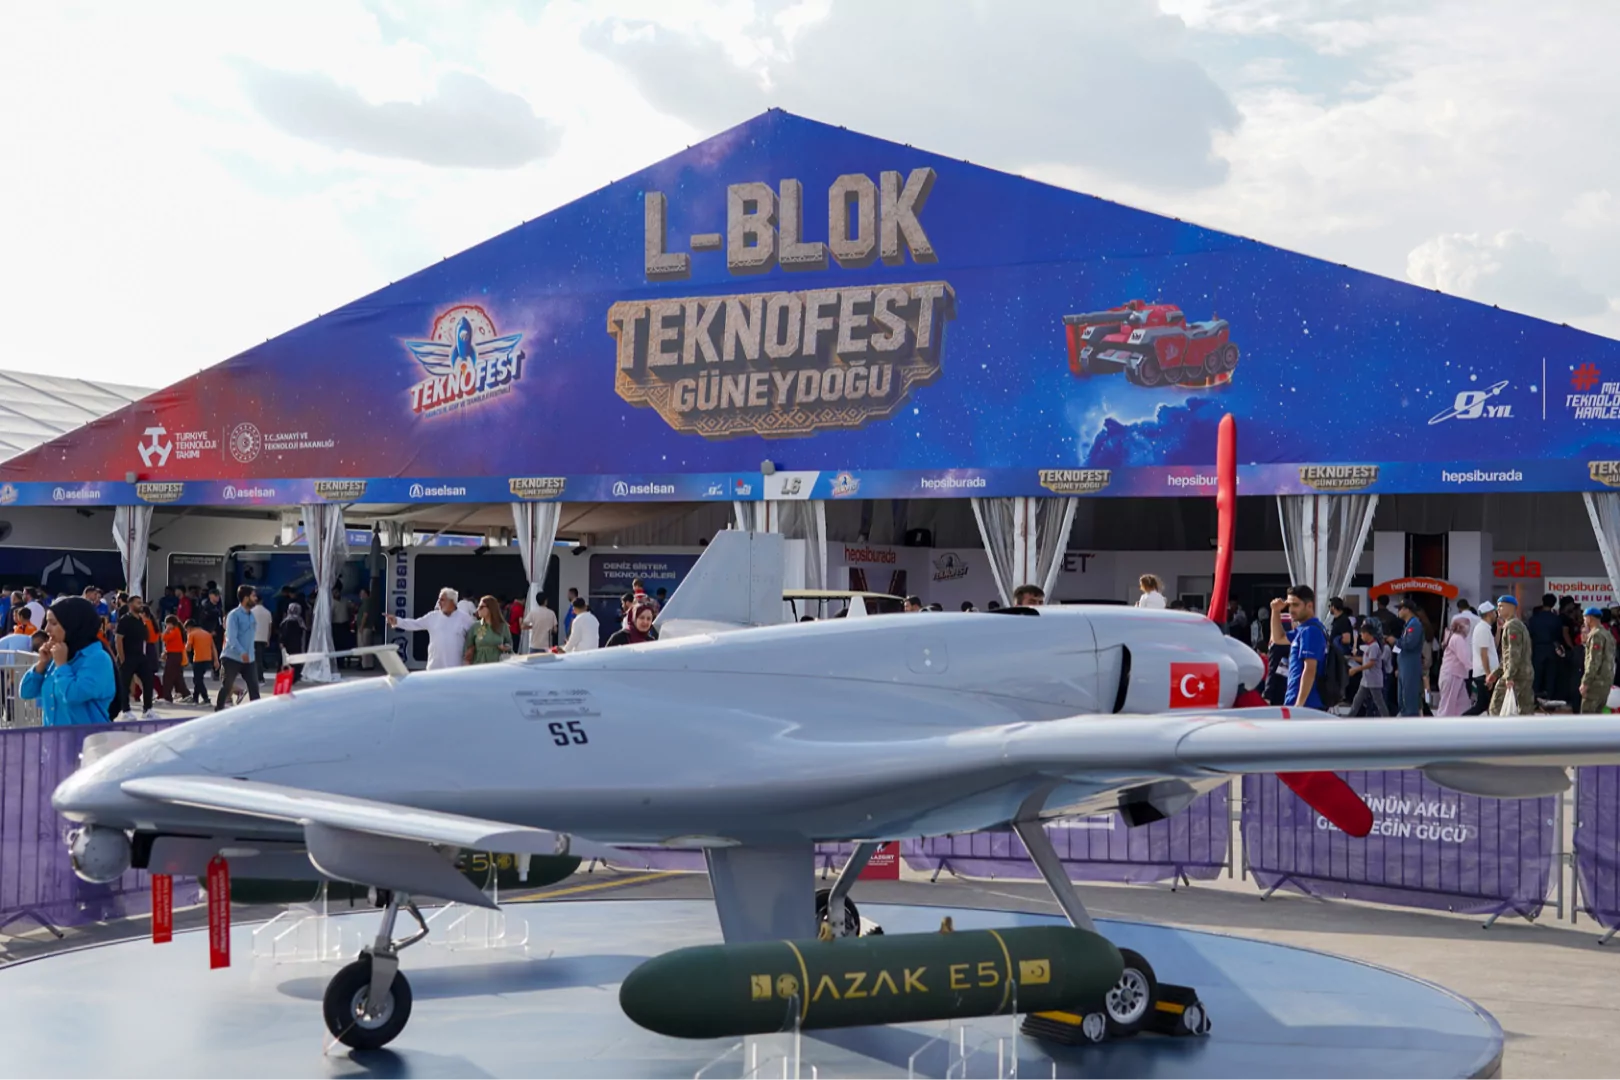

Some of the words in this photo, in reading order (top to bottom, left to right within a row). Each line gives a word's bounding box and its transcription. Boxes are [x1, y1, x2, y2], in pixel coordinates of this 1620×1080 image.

[645, 167, 938, 280] L-BLOK
[612, 283, 946, 371] TEKNOFEST
[411, 350, 525, 413] TEKNOFEST
[672, 360, 894, 413] GÜNEYDOĞU
[1038, 470, 1111, 482] TEKNOFEST
[1299, 465, 1379, 479] TEKNOFEST
[1442, 469, 1523, 484] hepsiburada
[136, 483, 184, 493] TEKNOFEST
[315, 480, 367, 491] TEKNOFEST
[509, 477, 566, 489] TEKNOFEST
[921, 476, 986, 490] hepsiburada
[1167, 474, 1240, 488] hepsibur
[66, 488, 100, 499] aselsan
[238, 487, 275, 497] aselsan
[425, 485, 466, 496] aselsan
[629, 483, 675, 494] aselsan
[844, 545, 896, 565] hepsiburada
[603, 561, 631, 569] DENİZ
[632, 562, 668, 570] SİSTEM
[1492, 555, 1541, 578] ada
[603, 571, 676, 579] TEKNOLOJİLERİ
[1391, 580, 1443, 591] hepsiburada
[1548, 581, 1613, 593] hepsiburad
[1414, 802, 1457, 819] AKLI
[1416, 822, 1467, 843] GÜCÜ
[949, 962, 999, 989] E5
